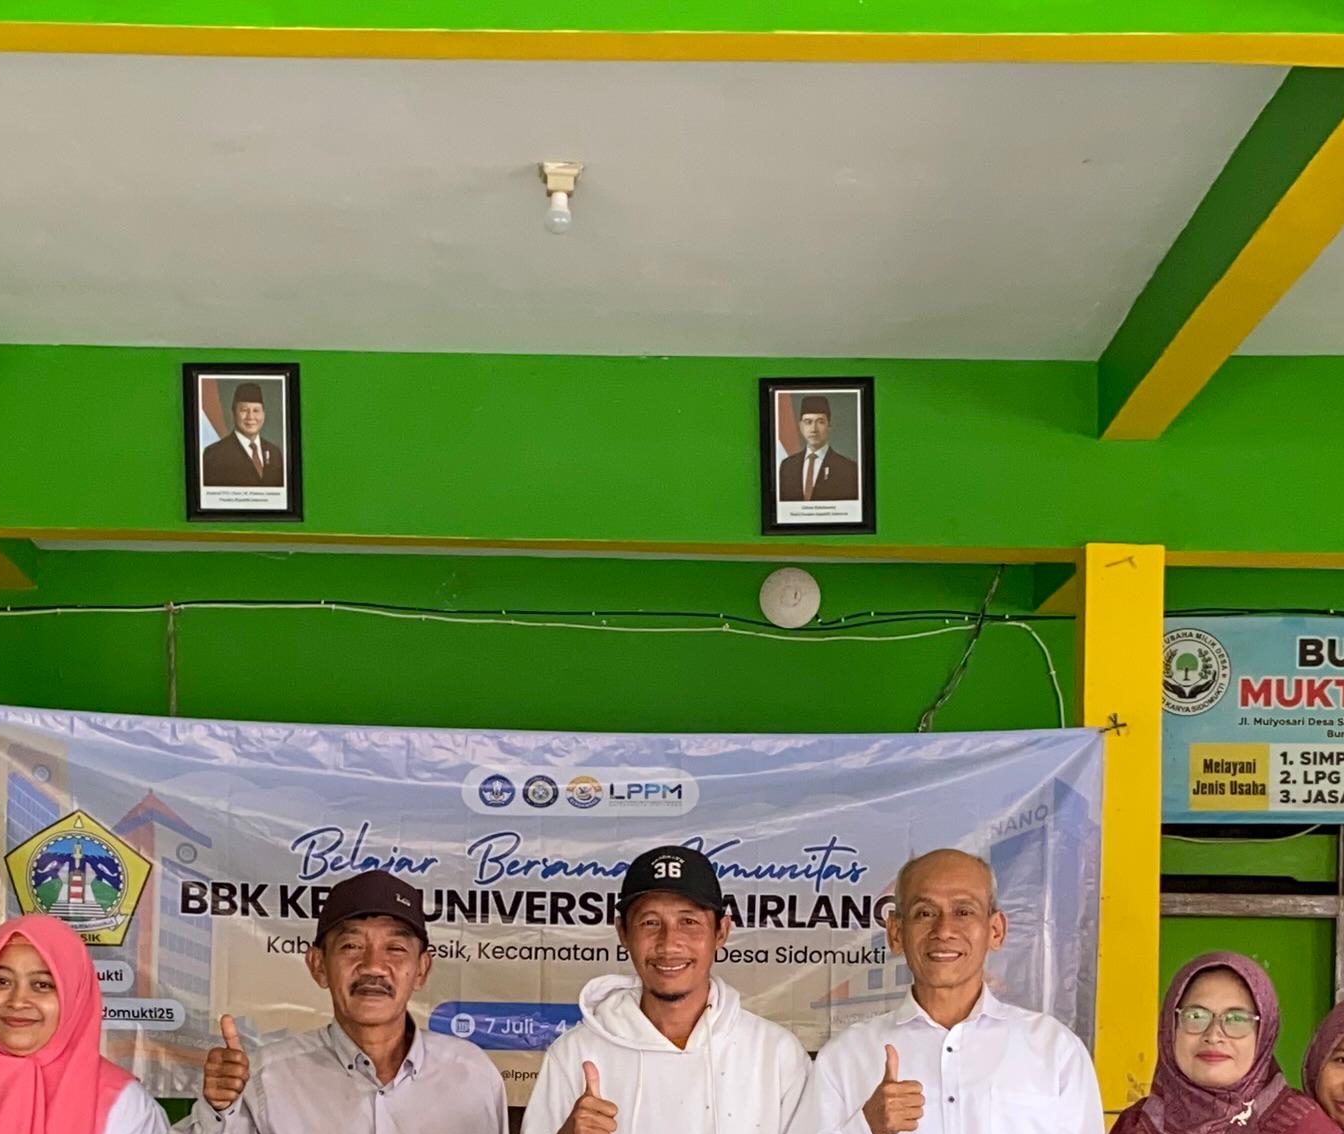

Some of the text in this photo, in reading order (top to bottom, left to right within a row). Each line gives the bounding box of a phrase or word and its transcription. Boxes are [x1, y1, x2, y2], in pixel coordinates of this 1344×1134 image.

[1308, 717, 1334, 727] Desa
[1280, 751, 1294, 766] 1.
[1203, 758, 1257, 776] Melayani
[1280, 770, 1341, 785] 2. LPG
[609, 783, 683, 800] LPPM
[1192, 780, 1267, 796] Jenis Usaha
[1279, 789, 1296, 804] 3.
[291, 822, 867, 892] Belajar Bersama Kmunitas
[654, 862, 682, 879] 36
[180, 881, 270, 918] BBK
[419, 889, 620, 926] UNIVERSI
[478, 941, 609, 962] Kecamatan
[714, 946, 769, 964] Desa
[775, 945, 886, 965] Sidomukti
[485, 1018, 495, 1034] 7
[501, 1018, 534, 1034] Juli
[555, 1019, 567, 1034] 4
